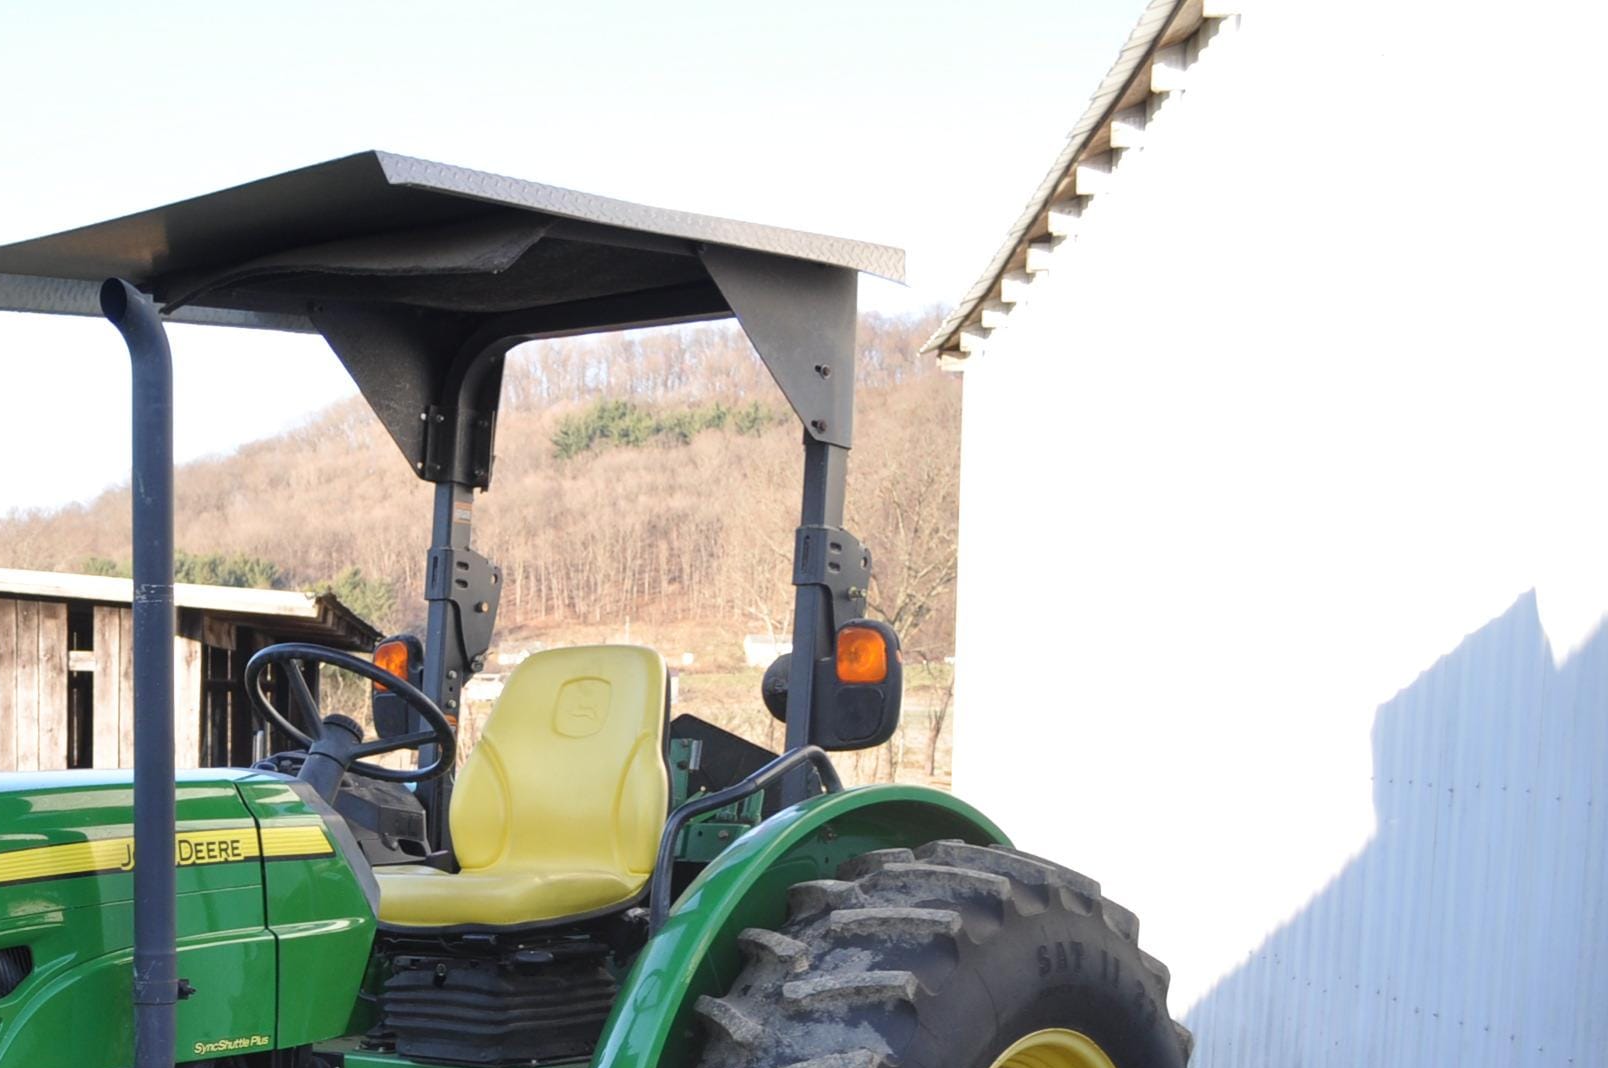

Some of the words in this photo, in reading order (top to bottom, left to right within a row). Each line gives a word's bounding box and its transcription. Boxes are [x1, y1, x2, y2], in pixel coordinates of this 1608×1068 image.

[177, 839, 242, 862] DEERE
[194, 1038, 250, 1055] SyncShuttle
[250, 1035, 270, 1047] Plus
